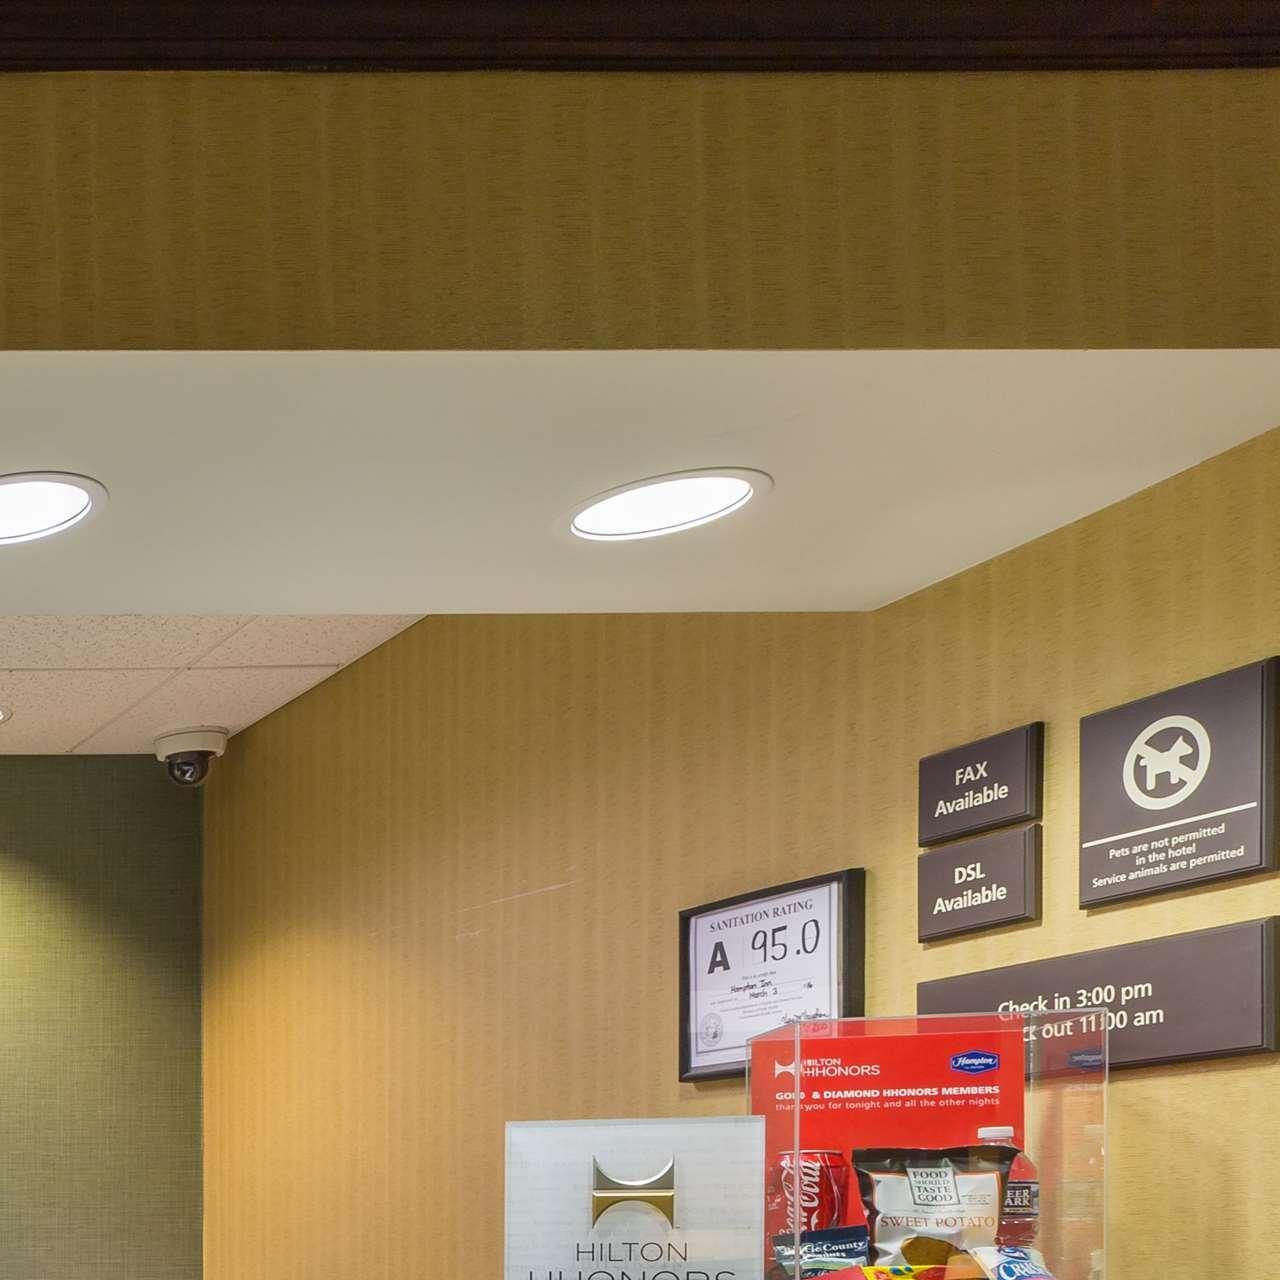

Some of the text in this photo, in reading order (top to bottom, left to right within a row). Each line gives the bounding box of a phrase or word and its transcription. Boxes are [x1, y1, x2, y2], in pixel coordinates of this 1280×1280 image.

[955, 760, 988, 786] FAX
[934, 782, 1009, 817] Available
[1108, 823, 1226, 860] Pets are not permitted
[1135, 842, 1196, 866] in the hotel
[954, 862, 986, 884] DSL
[1092, 845, 1245, 889] Service animals are permitted
[933, 883, 1007, 915] Available
[709, 898, 814, 933] SANITATION RATING
[751, 918, 821, 963] 95.0
[707, 940, 731, 975] A
[997, 982, 1153, 1021] Check in 3:00 pm
[1042, 1020, 1073, 1039] out
[1133, 1009, 1164, 1027] am
[803, 1058, 841, 1067] HILTON
[811, 1091, 821, 1100] &
[823, 1089, 880, 1099] DIAMOND
[882, 1087, 938, 1097] HHONORS
[941, 1085, 1001, 1095] MEMBERS
[828, 1101, 842, 1110] for
[845, 1100, 881, 1111] tonight
[883, 1099, 901, 1108] and
[905, 1098, 917, 1107] all
[920, 1097, 936, 1107] the
[938, 1097, 965, 1107] other
[969, 1096, 1000, 1107] nights
[912, 1170, 948, 1179] FOOD
[915, 1185, 951, 1193] TASTE
[917, 1193, 953, 1202] GOOD
[1007, 1189, 1030, 1198] EER
[1004, 1197, 1030, 1206] ARK
[880, 1214, 996, 1228] SWEET POTATO
[576, 1242, 688, 1262] HILTON
